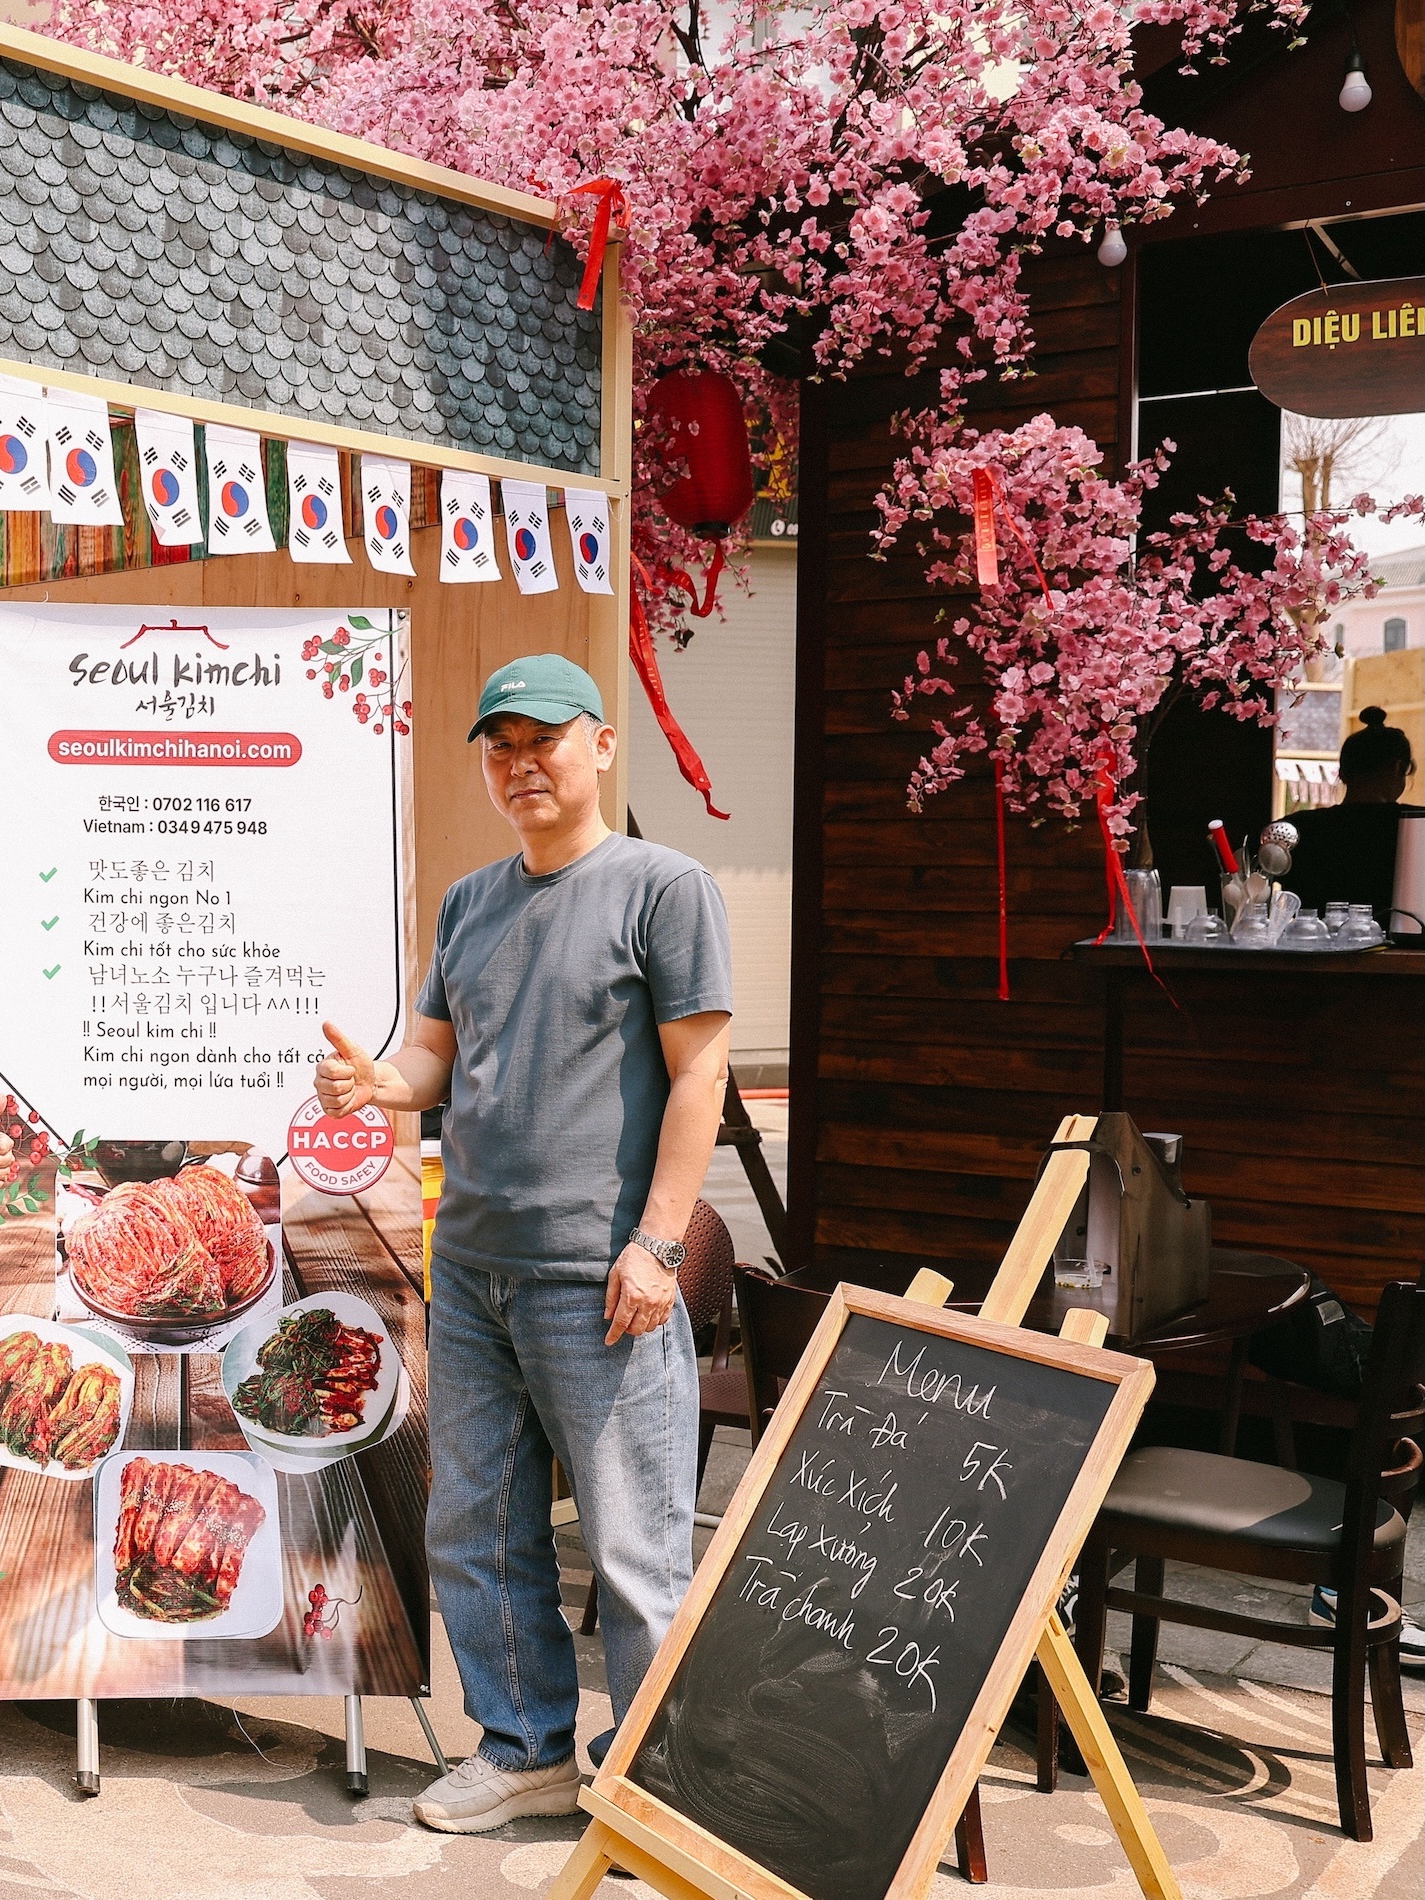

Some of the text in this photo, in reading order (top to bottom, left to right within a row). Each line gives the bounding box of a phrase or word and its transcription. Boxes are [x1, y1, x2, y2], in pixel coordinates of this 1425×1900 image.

[1292, 310, 1360, 350] DIỆU
[68, 651, 281, 688] Seoul kimchi
[500, 680, 526, 692] FILA
[135, 690, 215, 722] 서울김치
[58, 737, 292, 760] seoulkimchihanoi.com
[98, 795, 140, 812] 한국인
[152, 797, 193, 812] 0702
[196, 798, 221, 812] 116
[225, 798, 252, 812] 617
[83, 819, 145, 834] Vietnam
[157, 820, 201, 834] 0349
[203, 820, 234, 834] 475
[236, 820, 268, 835] 948
[88, 858, 215, 883] 맛도좋은 김치
[84, 887, 231, 909] Kim chi ngon No 1
[88, 911, 236, 935] 건강에 좋은김치
[84, 940, 281, 958] Kim chi tốt cho sức khỏe
[88, 963, 326, 988] 남녀노소 누구나 즐겨먹는
[200, 992, 262, 1016] 입니다
[97, 1021, 140, 1038] Seoul
[147, 1021, 174, 1038] kim
[180, 1022, 203, 1038] chi
[84, 1046, 324, 1066] Kim chi ngon dành cho tất cả
[84, 1073, 112, 1090] mọi
[119, 1073, 167, 1090] người,
[174, 1073, 202, 1090] mọi
[209, 1071, 233, 1088] lứa
[240, 1071, 271, 1088] tuổi
[292, 1131, 387, 1149] HACCP
[304, 1160, 376, 1186] FOOD SAFEY
[876, 1340, 996, 1420] Menu
[818, 1390, 871, 1431] Trà
[959, 1441, 1013, 1501] 5K
[789, 1450, 988, 1566] Xúc Xích 10K
[892, 1567, 960, 1623] 20K
[739, 1555, 941, 1714] Trà chanh 20K
